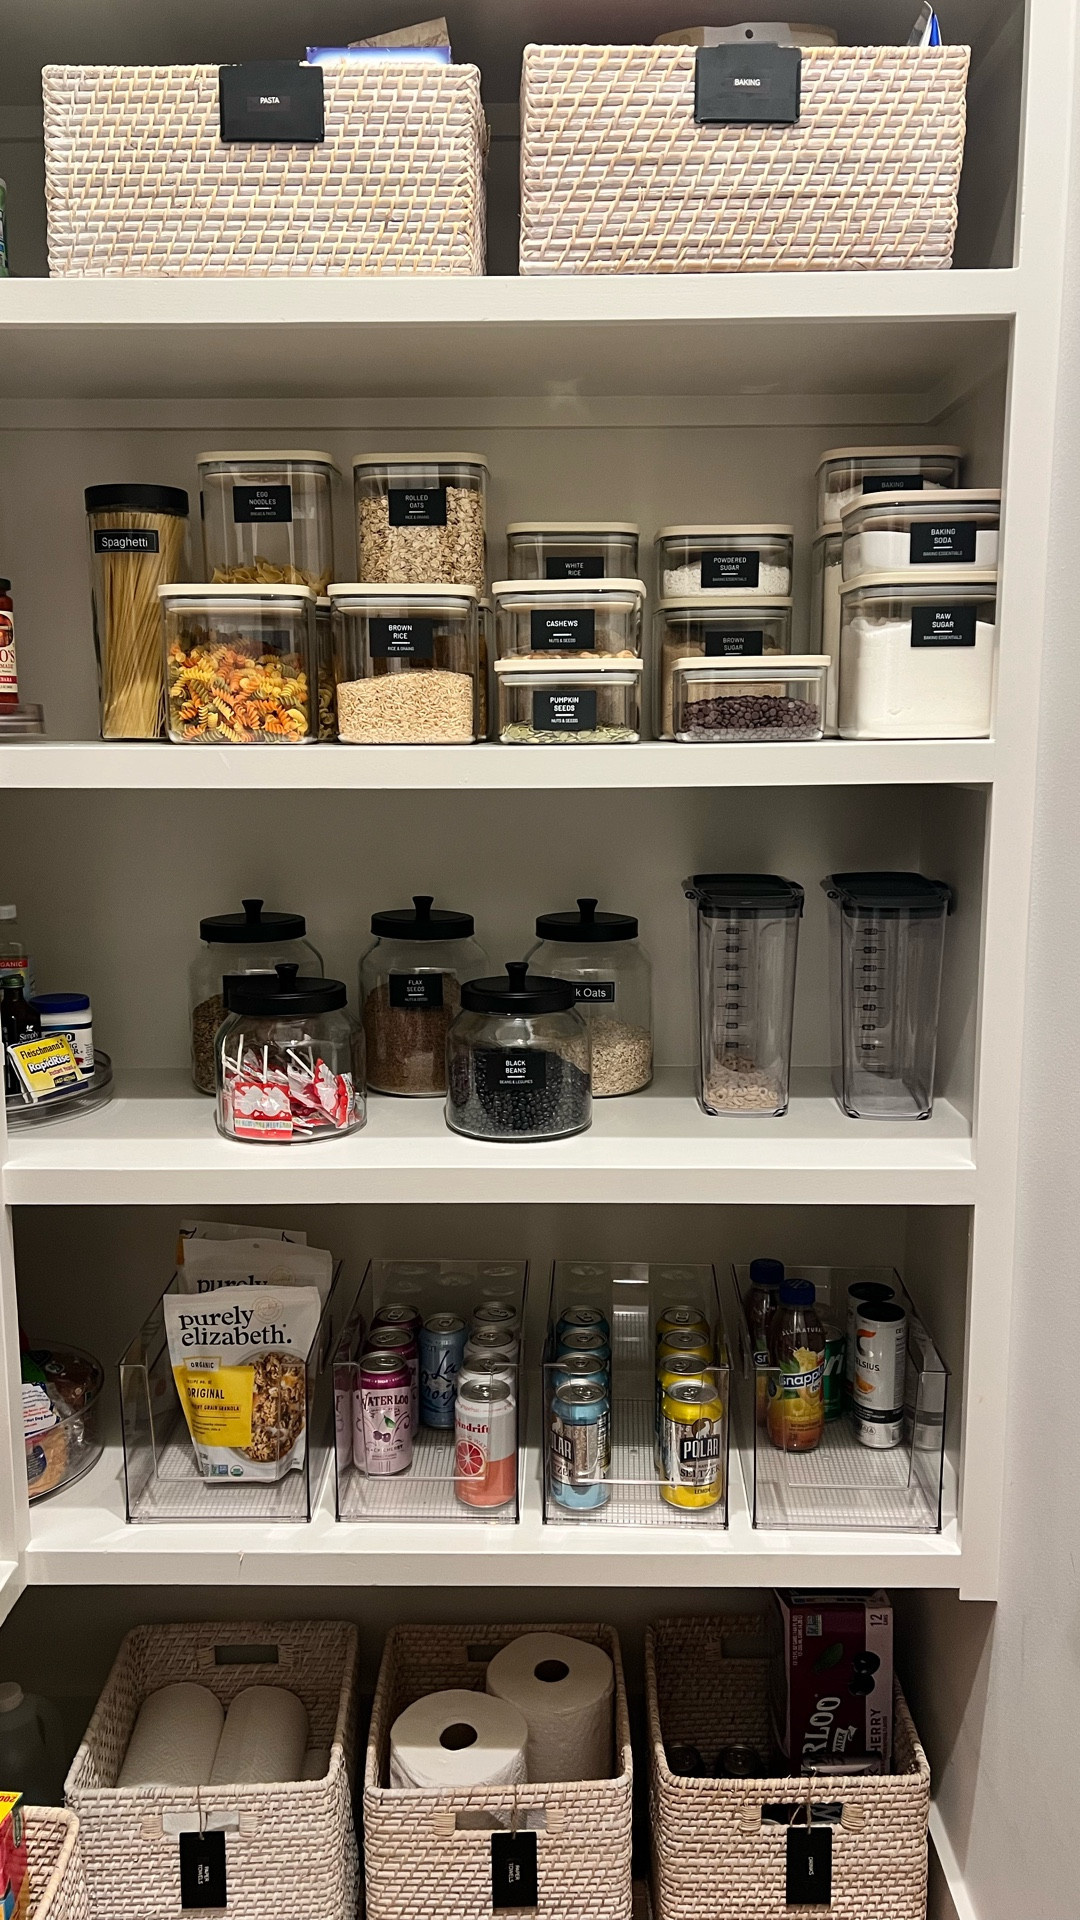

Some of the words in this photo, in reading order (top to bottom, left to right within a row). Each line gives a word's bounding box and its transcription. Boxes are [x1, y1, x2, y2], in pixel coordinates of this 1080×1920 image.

[734, 78, 761, 86] BAKING
[259, 96, 280, 104] PASTA
[930, 528, 956, 536] BAKING
[101, 537, 148, 549] Spaghetti
[933, 536, 952, 544] SODA
[935, 612, 952, 620] RAW
[932, 620, 955, 628] SUGAR
[393, 632, 408, 640] RICE
[549, 696, 579, 704] PUMPKIN
[553, 704, 576, 712] SEEDS
[583, 987, 607, 998] Oats
[20, 1041, 65, 1060] Fleischmann's
[28, 1054, 71, 1073] RapidRise
[179, 1306, 254, 1330] purely
[181, 1325, 292, 1346] elizabeth.
[190, 1361, 214, 1369] ORGANIC
[431, 1350, 458, 1382] La
[855, 1357, 880, 1372] ELSIUS
[780, 1363, 825, 1386] snappl
[187, 1388, 225, 1399] ORIGINAL
[362, 1392, 409, 1410] WATERLOO
[554, 1434, 572, 1460] LAR
[683, 1438, 719, 1459] POLAR
[680, 1465, 720, 1478] SELTZER
[870, 1614, 883, 1626] 12
[803, 1697, 841, 1754] RLOO
[870, 1708, 882, 1752] HERRY
